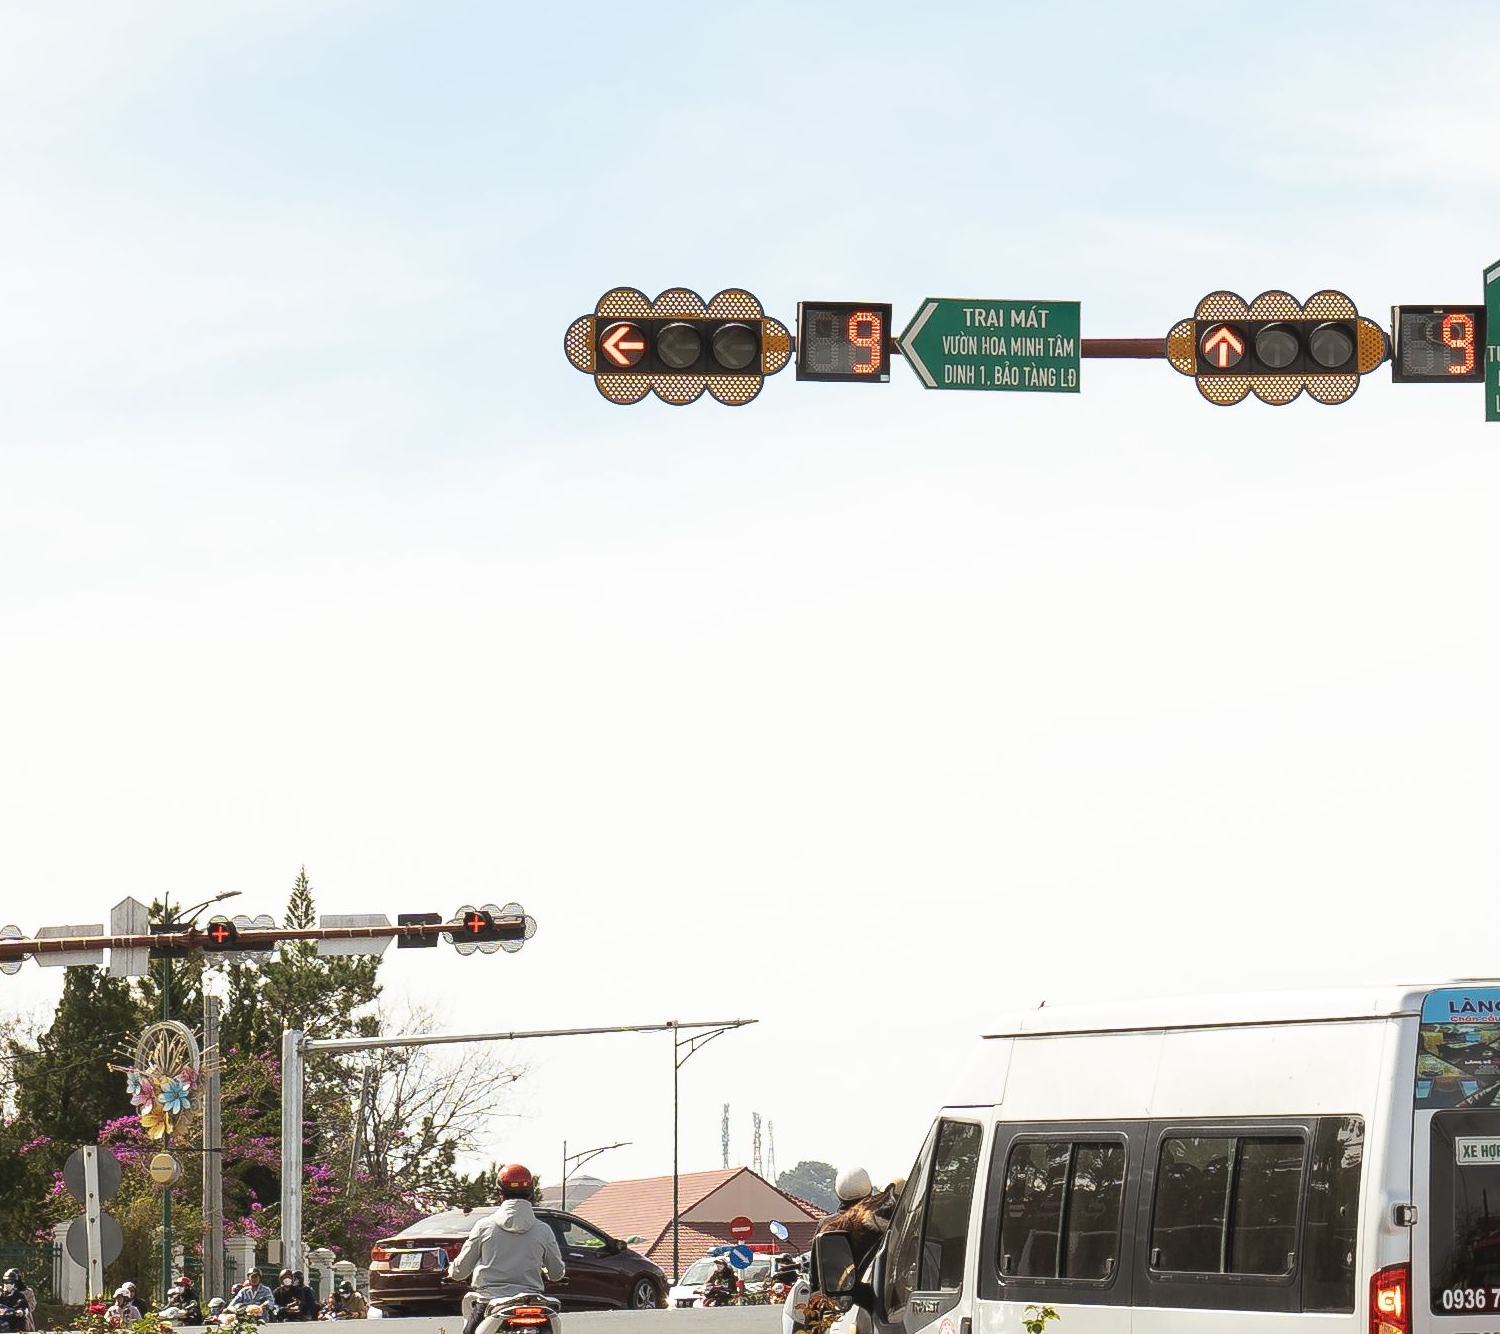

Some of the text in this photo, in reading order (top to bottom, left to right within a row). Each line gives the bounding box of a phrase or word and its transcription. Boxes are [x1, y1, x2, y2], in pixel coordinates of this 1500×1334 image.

[962, 305, 1050, 331] TRẠI MÁT
[942, 330, 1074, 357] VƯỜN HOA MINH TÂM
[944, 364, 975, 384] DINH
[994, 360, 1019, 386] BẢO
[1023, 362, 1056, 387] TÀNG
[1060, 368, 1077, 387] LĐ
[1462, 1144, 1478, 1158] XE
[1442, 1289, 1486, 1309] 0936
